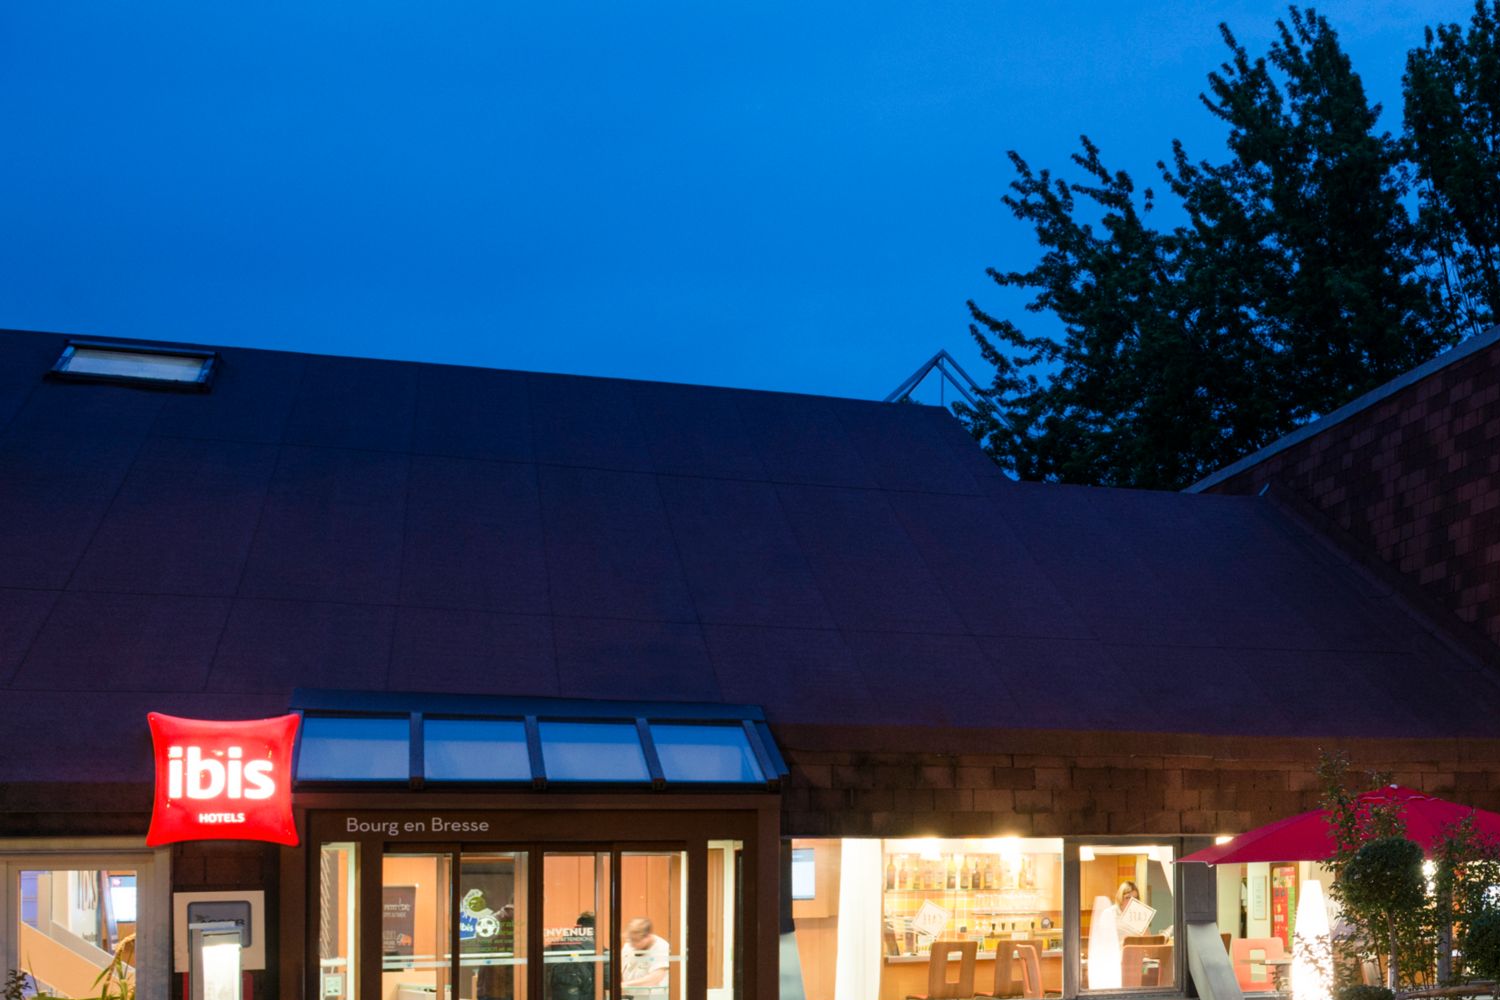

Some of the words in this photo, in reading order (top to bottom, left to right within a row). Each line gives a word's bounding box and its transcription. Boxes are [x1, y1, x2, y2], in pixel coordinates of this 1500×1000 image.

[168, 746, 276, 800] ibis
[198, 813, 245, 823] HOTELS
[346, 817, 399, 836] Bourg
[404, 821, 425, 832] en
[431, 816, 490, 832] Bresse
[543, 927, 594, 937] NVENUE
